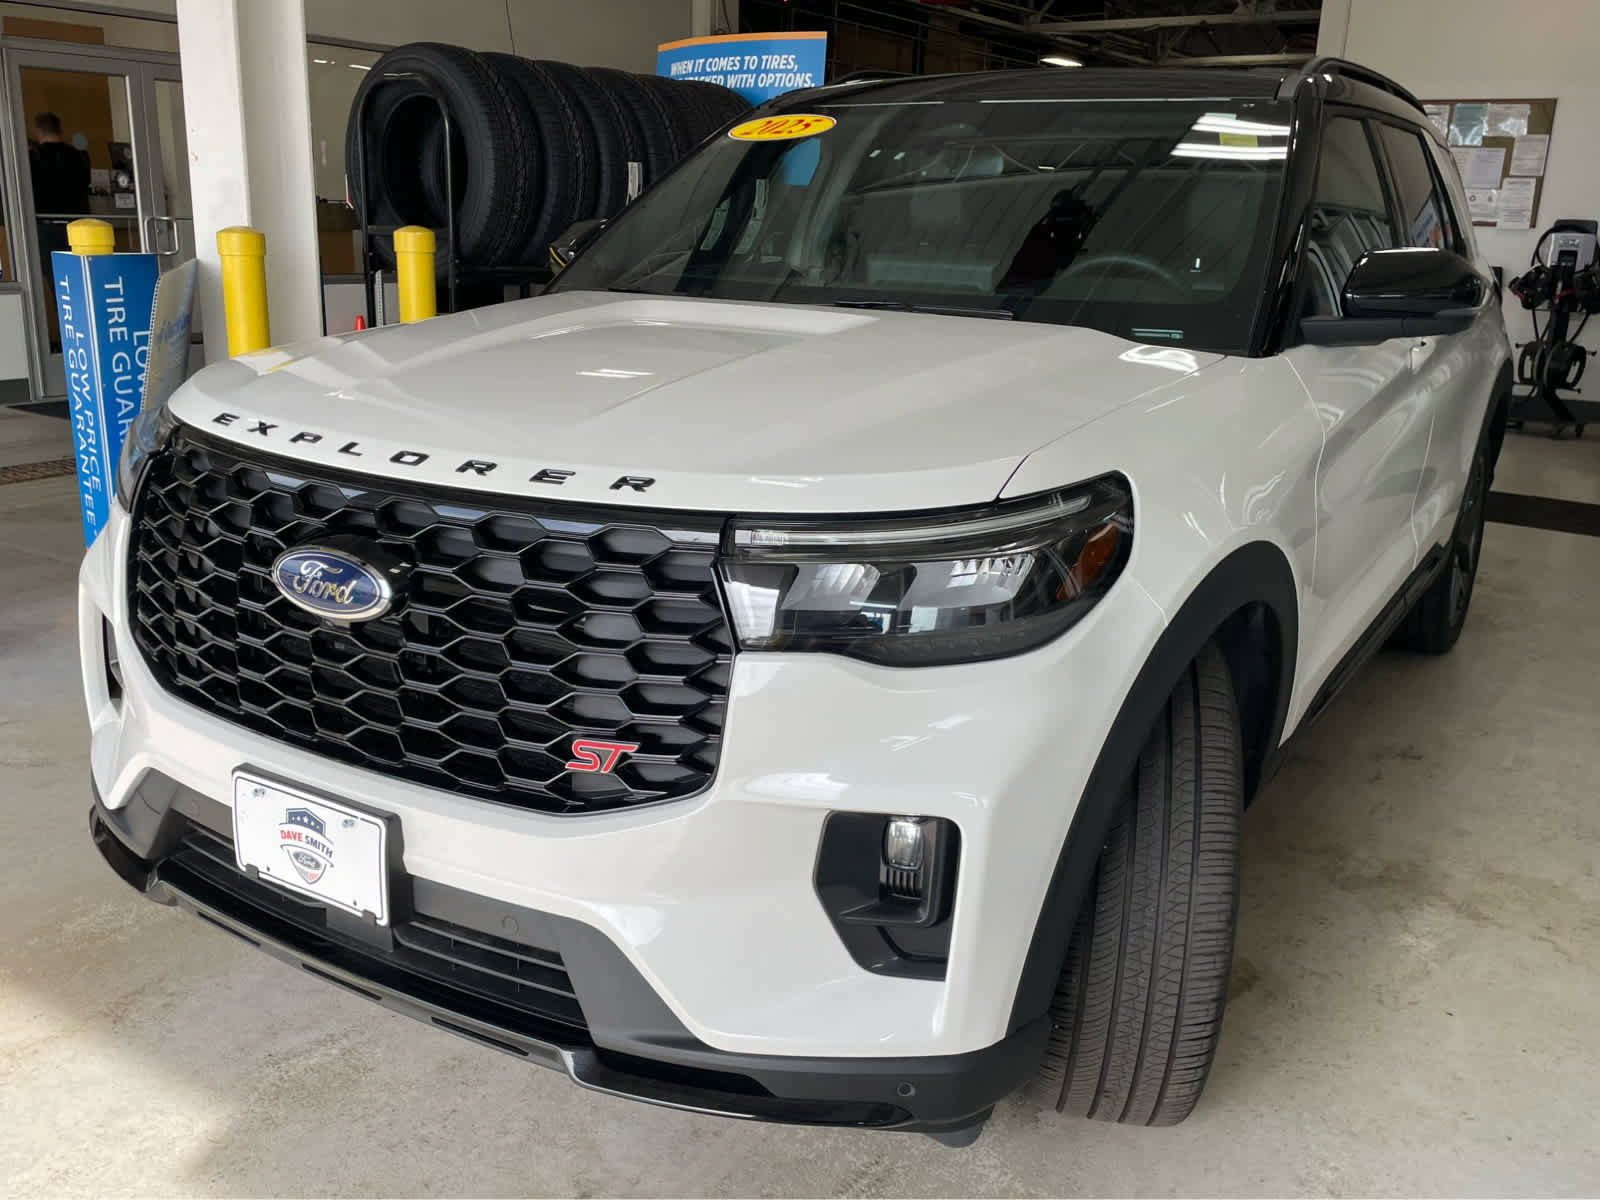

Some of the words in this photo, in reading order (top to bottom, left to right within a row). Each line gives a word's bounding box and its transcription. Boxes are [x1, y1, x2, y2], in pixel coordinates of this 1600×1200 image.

[670, 59, 694, 76] WHEN
[694, 58, 706, 73] IT
[706, 56, 742, 72] COMES
[743, 55, 759, 70] TO
[760, 54, 799, 72] TIRES,
[726, 73, 759, 89] WITH
[758, 72, 816, 88] OPTIONS.
[738, 118, 823, 136] 2025
[59, 274, 76, 340] TIRE
[104, 275, 128, 343] TIRE
[75, 331, 92, 402] LOW
[84, 410, 102, 492] PRICE
[212, 411, 657, 494] EXPLORER
[291, 559, 355, 606] Ford
[565, 739, 639, 774] ST
[279, 829, 303, 842] DAVE
[304, 834, 334, 858] SMITH
